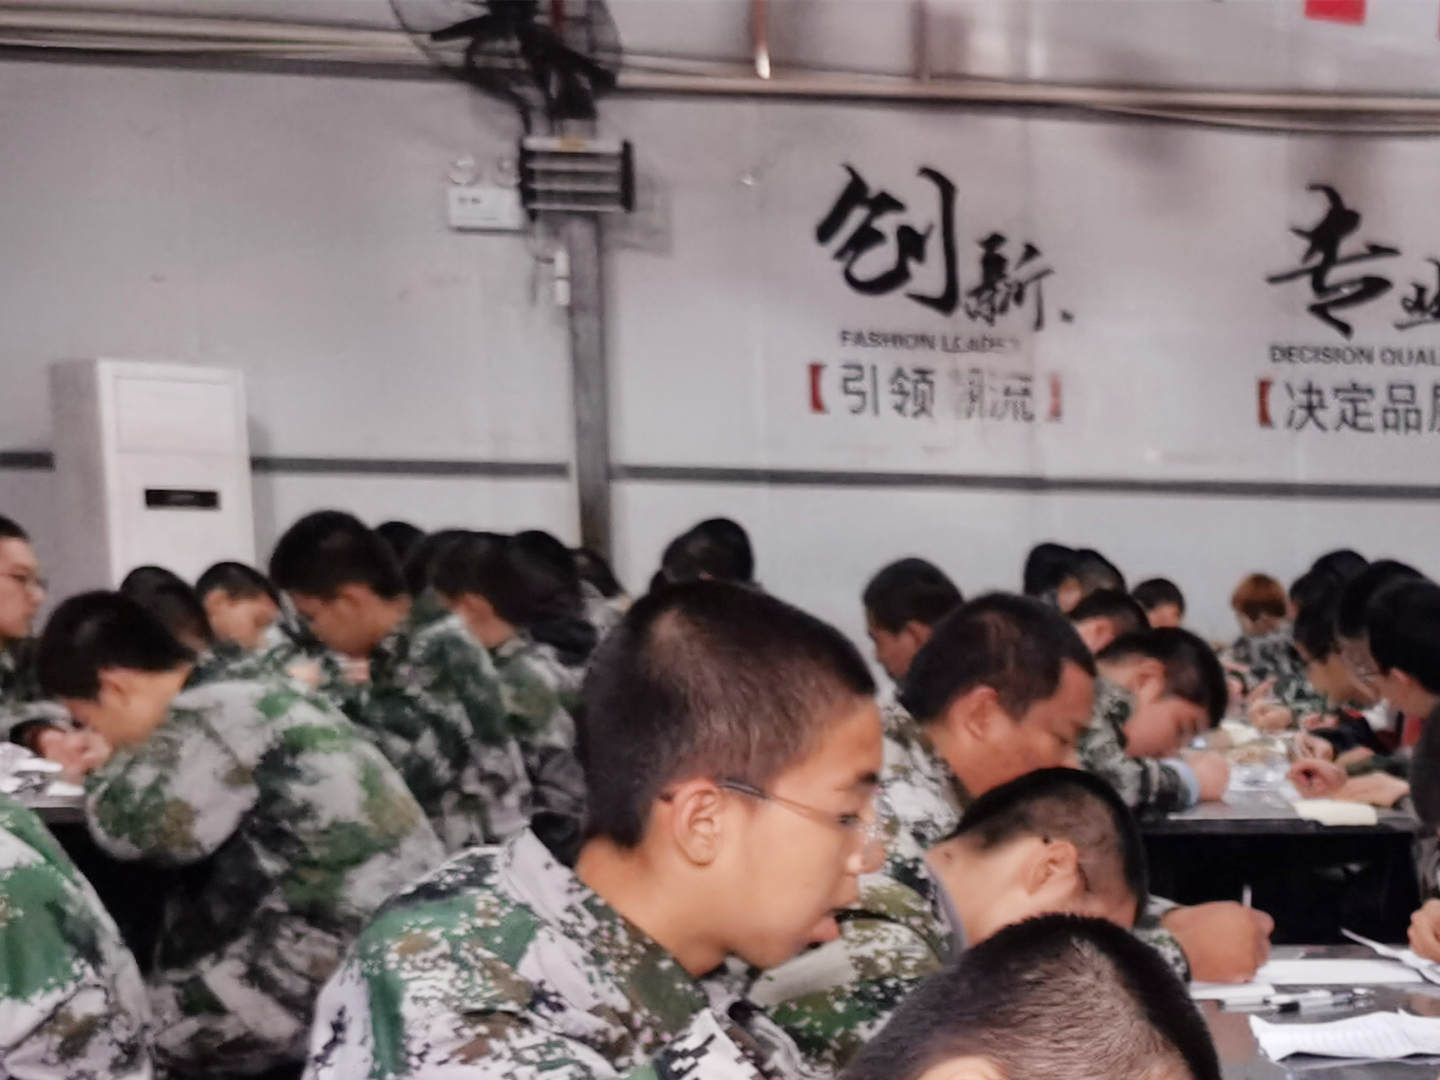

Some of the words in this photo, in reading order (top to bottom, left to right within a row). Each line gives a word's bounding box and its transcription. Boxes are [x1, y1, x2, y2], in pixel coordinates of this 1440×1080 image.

[816, 163, 1054, 332] 创新
[840, 330, 936, 351] FASHION
[1269, 345, 1375, 365] DECISION
